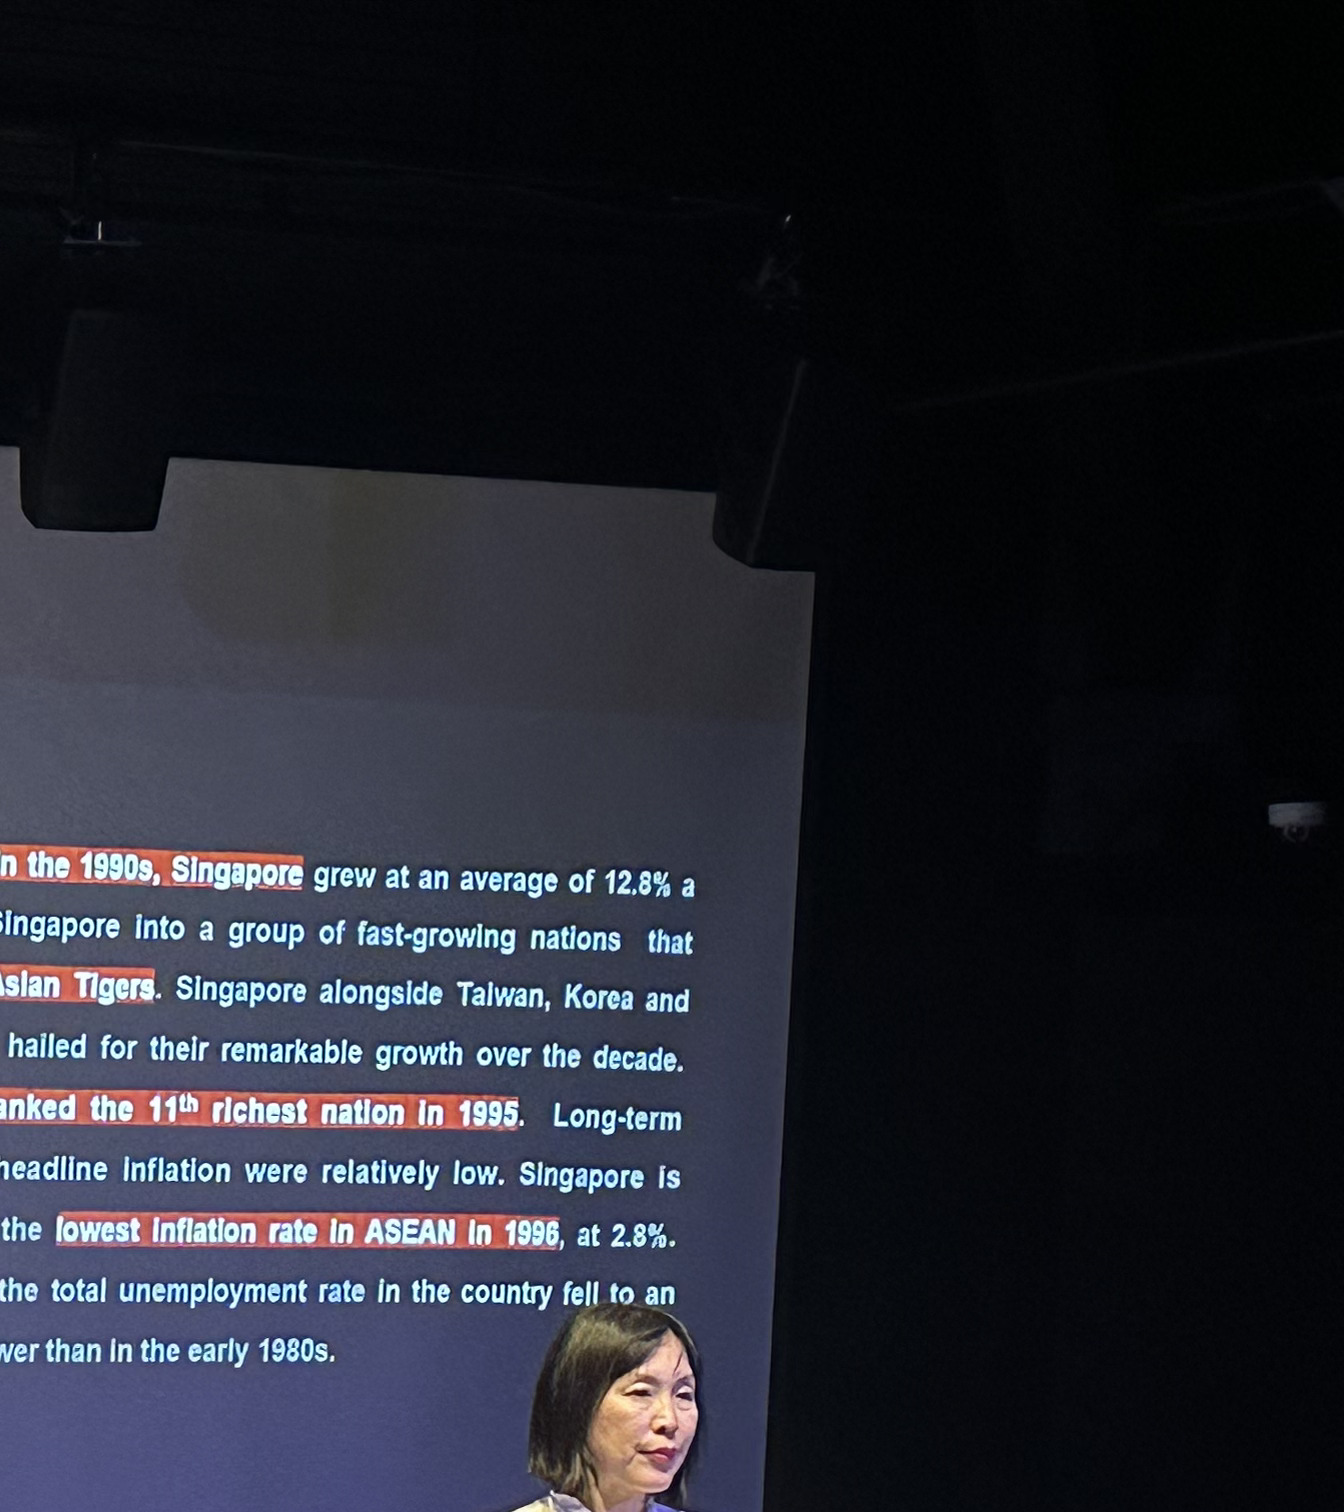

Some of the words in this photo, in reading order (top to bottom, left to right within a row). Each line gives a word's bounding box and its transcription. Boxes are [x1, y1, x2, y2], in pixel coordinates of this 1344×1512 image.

[27, 850, 71, 879] the
[80, 851, 161, 887] 1990s,
[171, 855, 304, 892] Singapore
[313, 866, 377, 893] grew
[384, 864, 411, 890] at
[418, 869, 450, 891] an
[459, 870, 559, 899] average
[568, 868, 597, 894] of
[604, 869, 672, 898] 12.8%
[681, 877, 696, 898] a
[135, 913, 186, 941] into
[199, 920, 214, 942] a
[228, 921, 305, 951] group
[318, 919, 346, 945] of
[357, 919, 517, 956] fast-growing
[530, 924, 622, 952] nations
[647, 928, 694, 956] that
[73, 971, 162, 1006] Tigers.
[175, 974, 307, 1009] Singapore
[319, 978, 444, 1012] alongside
[456, 980, 552, 1013] Taiwan,
[564, 983, 634, 1011] Korea
[644, 988, 690, 1014] and
[7, 1031, 87, 1059] hailed
[100, 1033, 139, 1061] for
[149, 1035, 210, 1062] their
[221, 1038, 364, 1065] remarkable
[375, 1040, 464, 1072] growth
[476, 1046, 533, 1068] over
[542, 1042, 582, 1069] the
[592, 1044, 684, 1073] decade.
[89, 1094, 134, 1122] the
[212, 1096, 308, 1129] richest
[320, 1098, 405, 1129] nation
[417, 1099, 444, 1127] in
[459, 1099, 525, 1131] 1995.
[553, 1102, 682, 1136] Long-term
[123, 1155, 231, 1183] inflation
[244, 1162, 308, 1184] were
[321, 1158, 440, 1191] relatively
[452, 1159, 505, 1186] low.
[519, 1161, 645, 1195] Singapore
[658, 1164, 681, 1190] is
[0, 1215, 43, 1242] the
[55, 1214, 141, 1246] lowest
[152, 1216, 257, 1244] inflation
[268, 1218, 318, 1245] rate
[329, 1218, 355, 1245] in
[363, 1218, 456, 1247] ASEAN
[468, 1218, 492, 1246] in
[504, 1219, 565, 1251] 1996,
[576, 1223, 601, 1248] at
[610, 1222, 676, 1249] 2.8%.
[50, 1276, 107, 1303] total
[119, 1277, 308, 1310] unemployment
[318, 1279, 366, 1303] rate
[377, 1277, 401, 1304] in
[411, 1278, 451, 1304] the
[460, 1280, 554, 1312] country
[562, 1280, 600, 1307] fell
[609, 1282, 635, 1306] to
[644, 1285, 676, 1306] an
[44, 1337, 102, 1363] than
[109, 1337, 133, 1363] in
[140, 1337, 181, 1363] the
[187, 1337, 250, 1369] early
[258, 1337, 335, 1363] 1980s.
